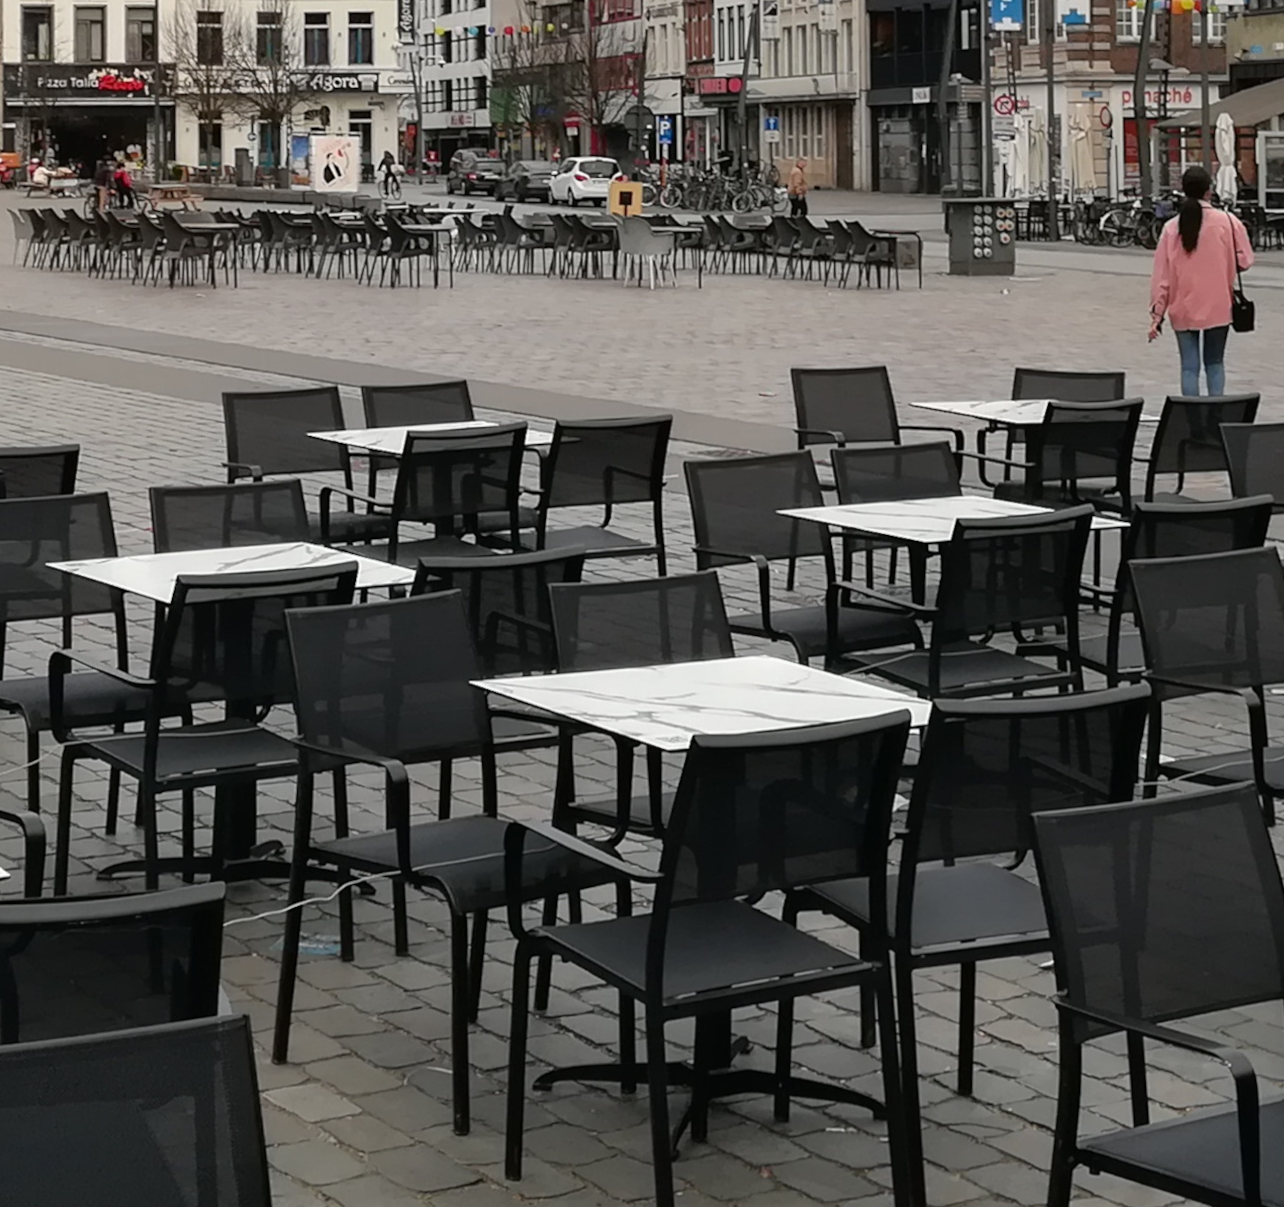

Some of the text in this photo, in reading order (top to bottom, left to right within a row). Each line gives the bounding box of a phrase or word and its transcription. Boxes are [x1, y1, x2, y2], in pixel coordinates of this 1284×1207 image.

[310, 74, 358, 92] Agora
[1122, 87, 1193, 105] pnaché
[659, 121, 671, 136] P
